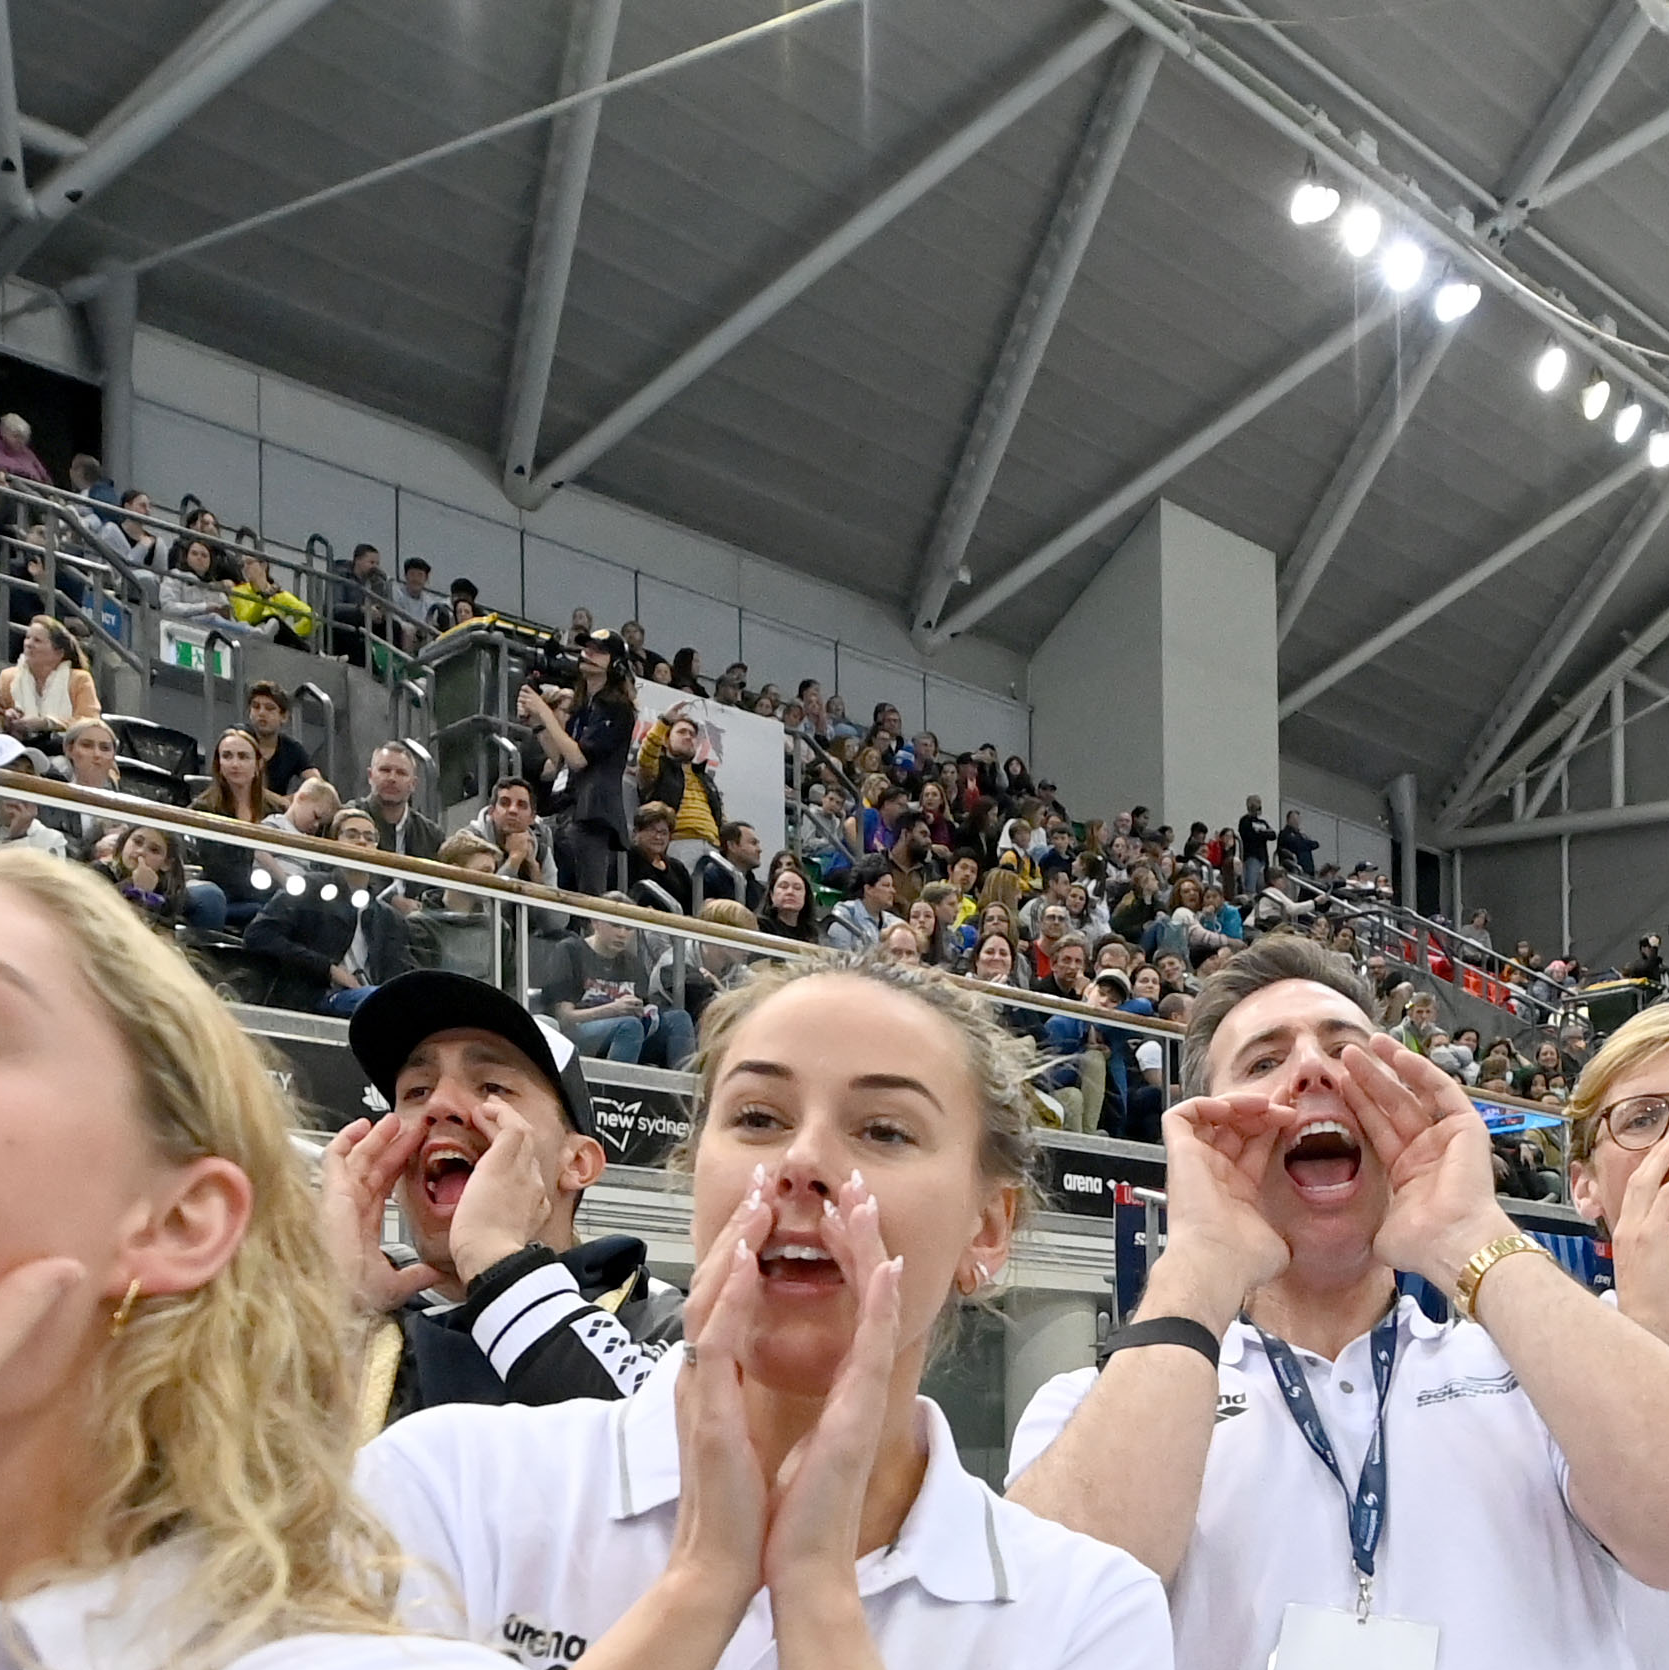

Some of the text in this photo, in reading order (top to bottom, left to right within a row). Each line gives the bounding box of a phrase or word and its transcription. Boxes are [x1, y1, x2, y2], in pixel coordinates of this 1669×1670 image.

[596, 1111, 635, 1129] new
[1063, 1173, 1103, 1194] arena
[503, 1613, 587, 1662] arena
